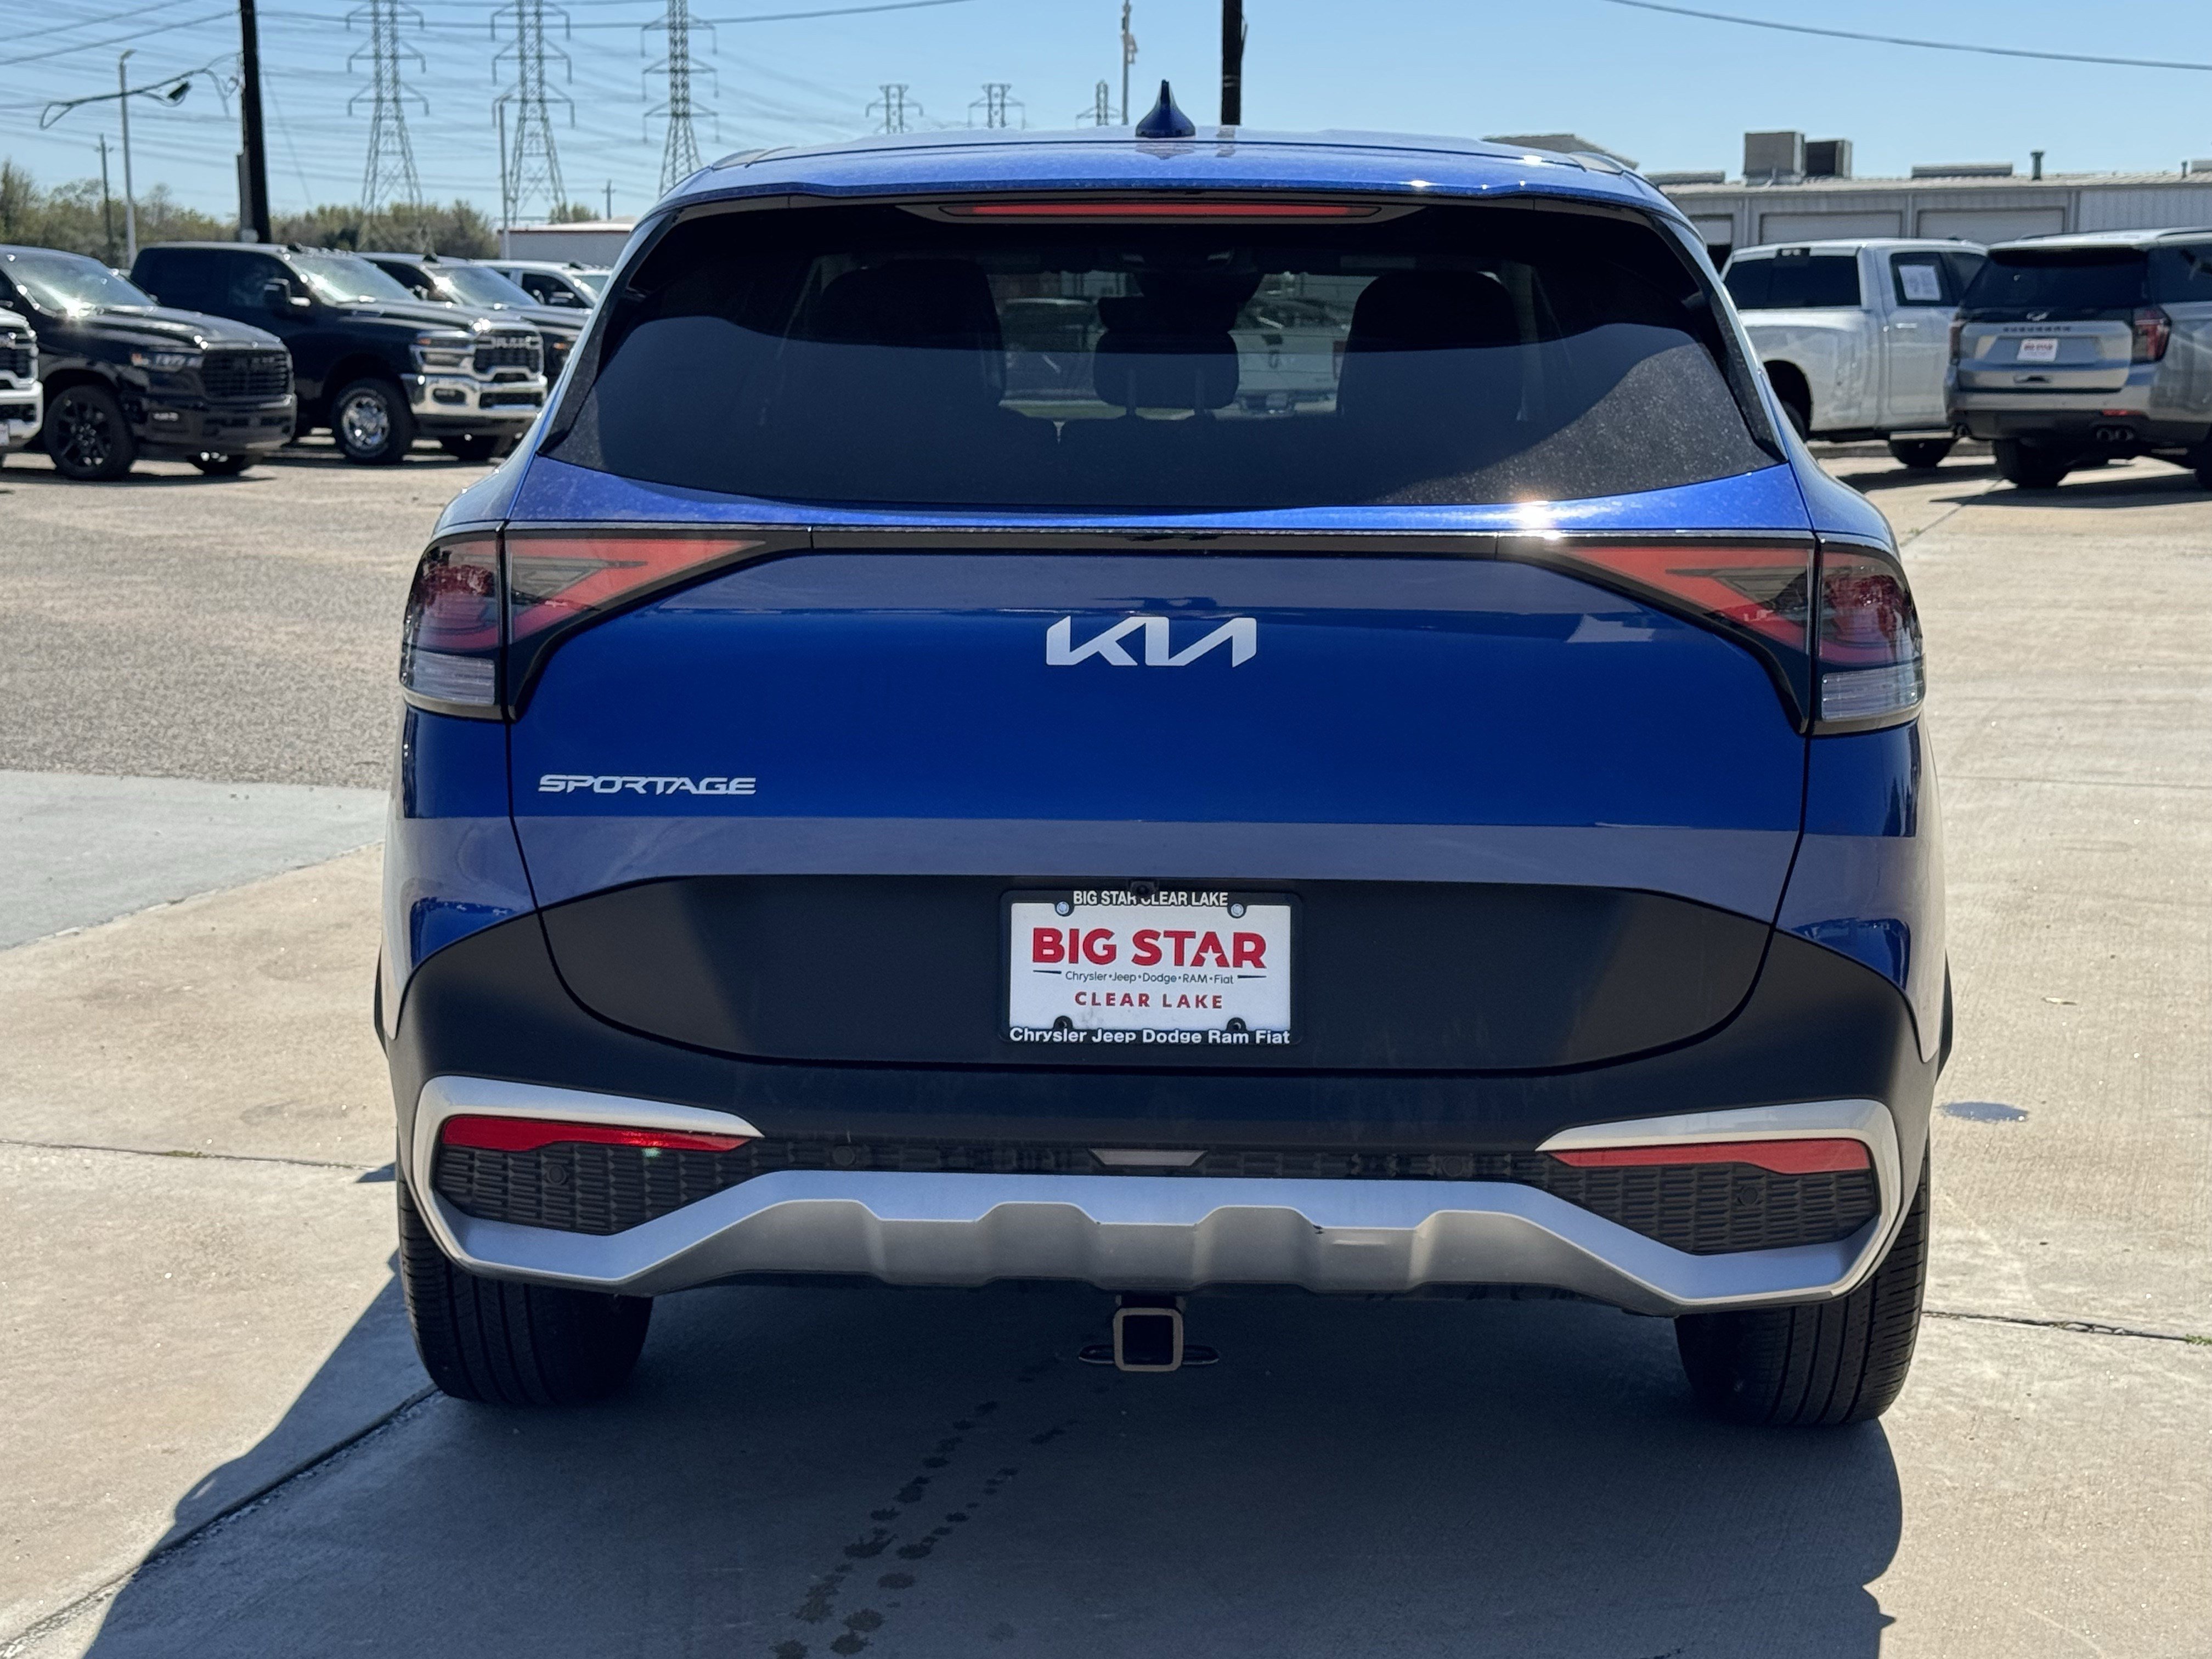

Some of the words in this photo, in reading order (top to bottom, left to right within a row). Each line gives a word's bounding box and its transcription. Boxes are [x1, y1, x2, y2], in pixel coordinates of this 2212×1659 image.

[1046, 616, 1257, 668] KIA
[538, 774, 756, 795] SPORTAGE
[1073, 890, 1097, 905] BIG
[1192, 892, 1228, 906] LAKE
[1032, 927, 1116, 965] BIG
[1131, 929, 1267, 969] STAR
[1065, 971, 1107, 983] Chrysler
[1112, 972, 1136, 984] Jeep
[1143, 973, 1177, 985] Dodge
[1183, 974, 1207, 983] RAM
[1214, 975, 1234, 984] Fiat
[1075, 991, 1150, 1007] CLEAR
[1163, 994, 1222, 1009] LAKE
[1009, 1027, 1087, 1042] Chrysler
[1092, 1028, 1136, 1043] Jeep
[1143, 1029, 1202, 1043] Dodge
[1208, 1030, 1249, 1044] Ram
[1256, 1030, 1290, 1044] Fiat
